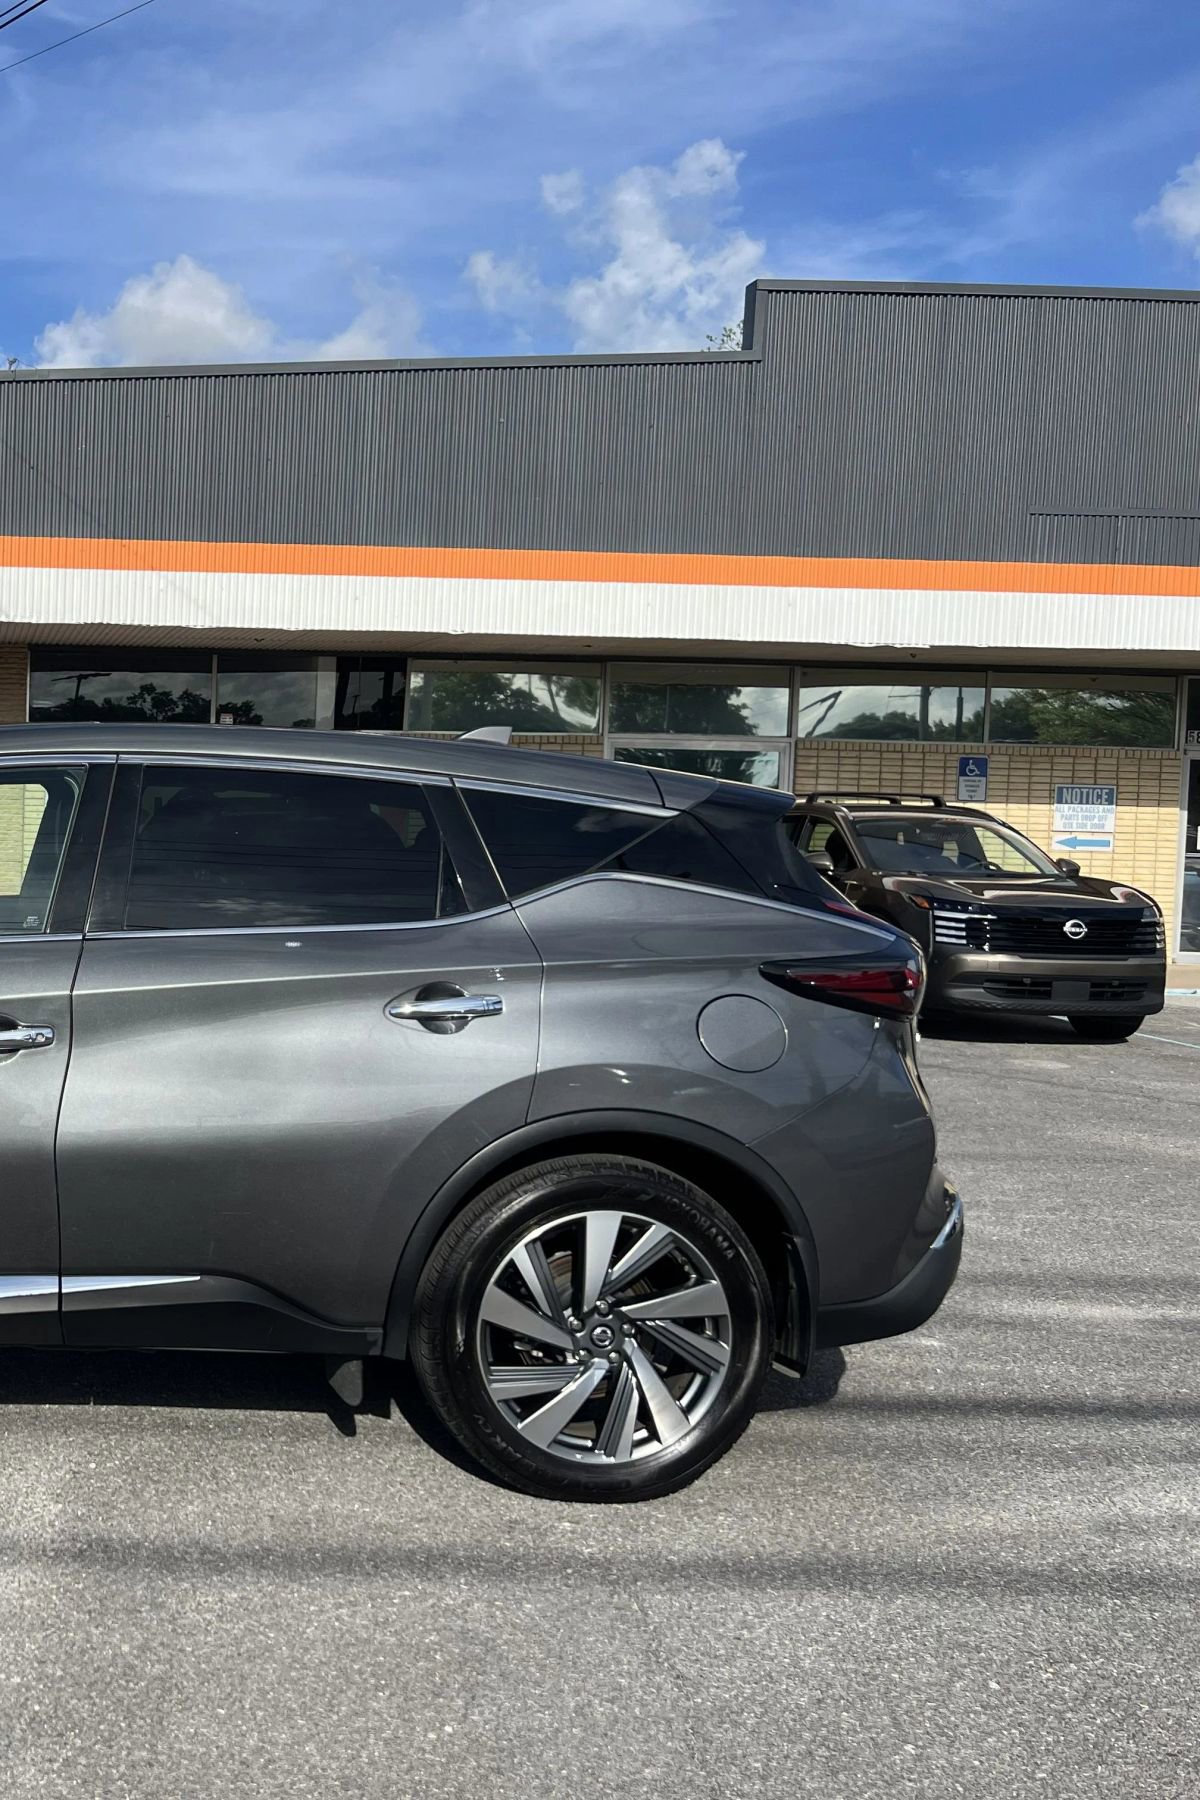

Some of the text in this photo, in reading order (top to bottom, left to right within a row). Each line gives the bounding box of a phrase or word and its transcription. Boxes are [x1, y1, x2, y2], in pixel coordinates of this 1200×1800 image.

[1062, 788, 1109, 805] NOTICE
[1067, 805, 1100, 814] PACKAGES
[1101, 806, 1115, 815] AND
